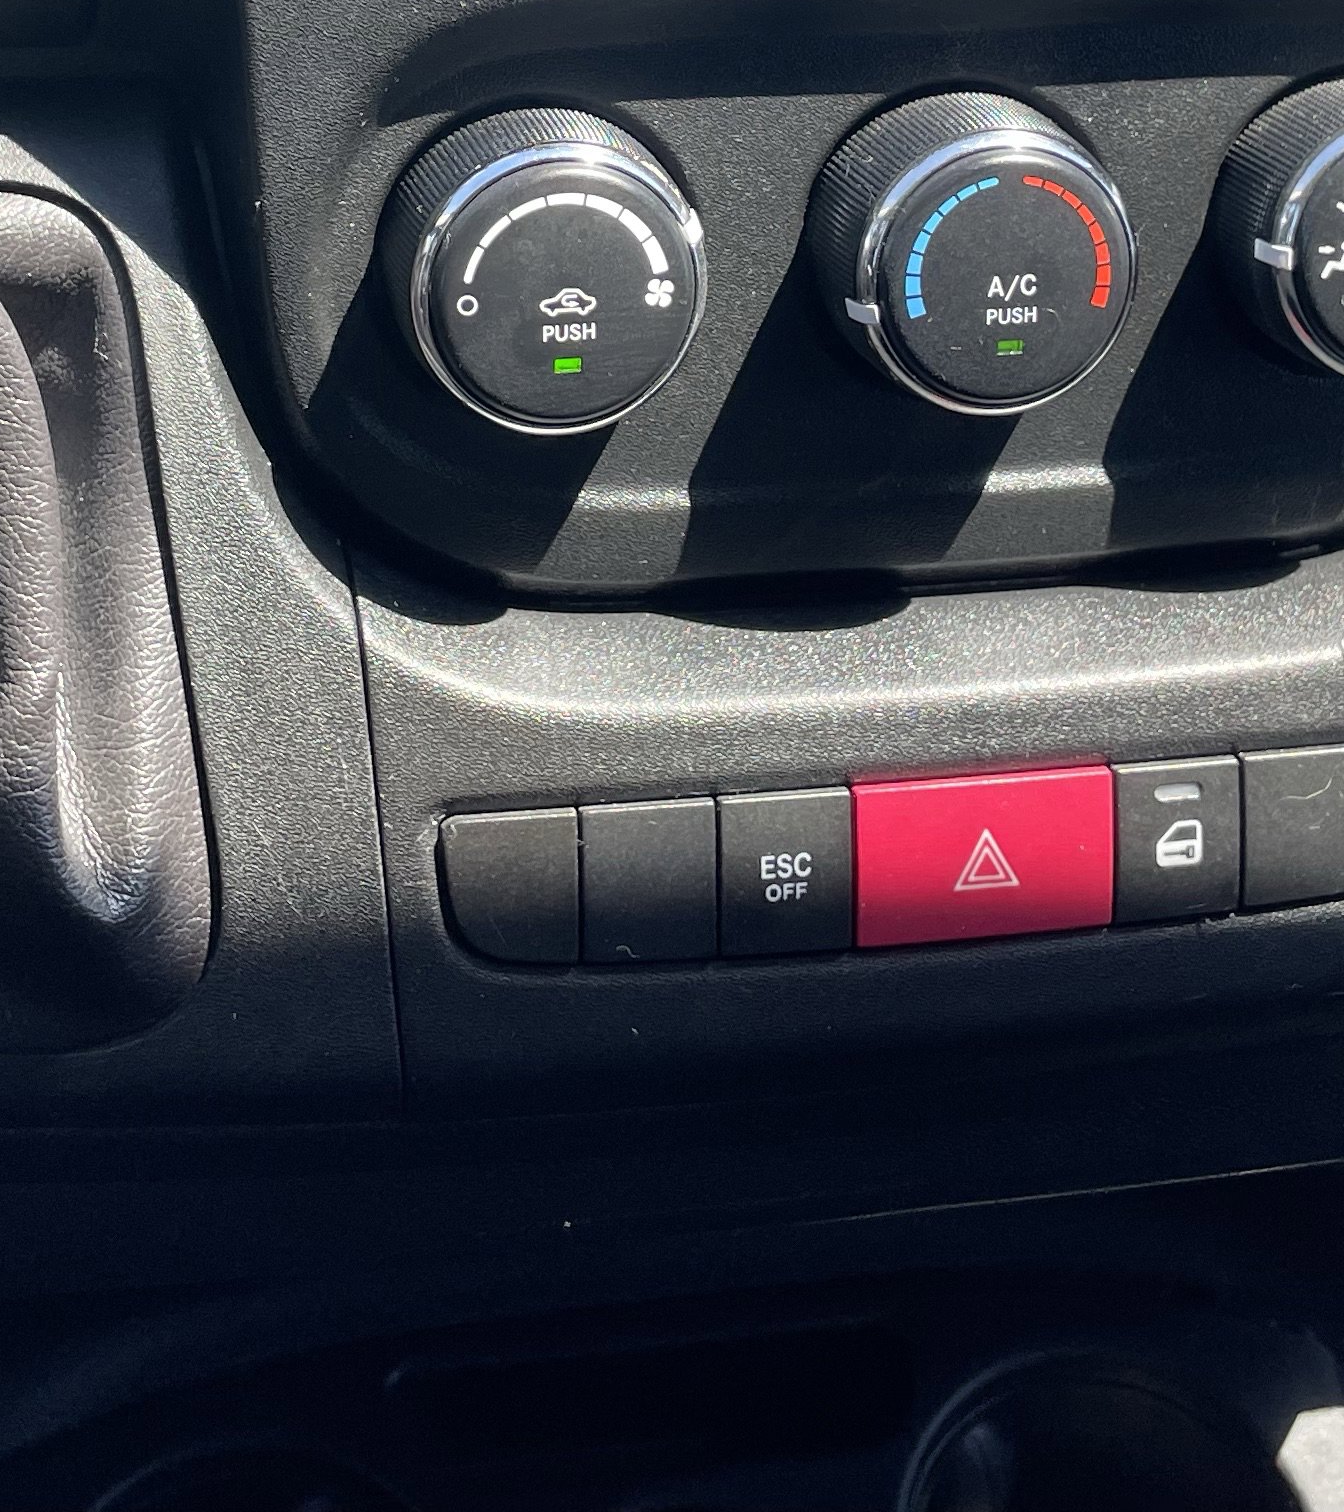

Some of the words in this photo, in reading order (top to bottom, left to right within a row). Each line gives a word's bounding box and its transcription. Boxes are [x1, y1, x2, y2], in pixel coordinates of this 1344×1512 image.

[988, 274, 1036, 301] A/C
[986, 306, 1037, 325] PUSH
[543, 322, 596, 342] PUSH
[761, 852, 811, 879] ESC
[766, 882, 808, 902] OFF
